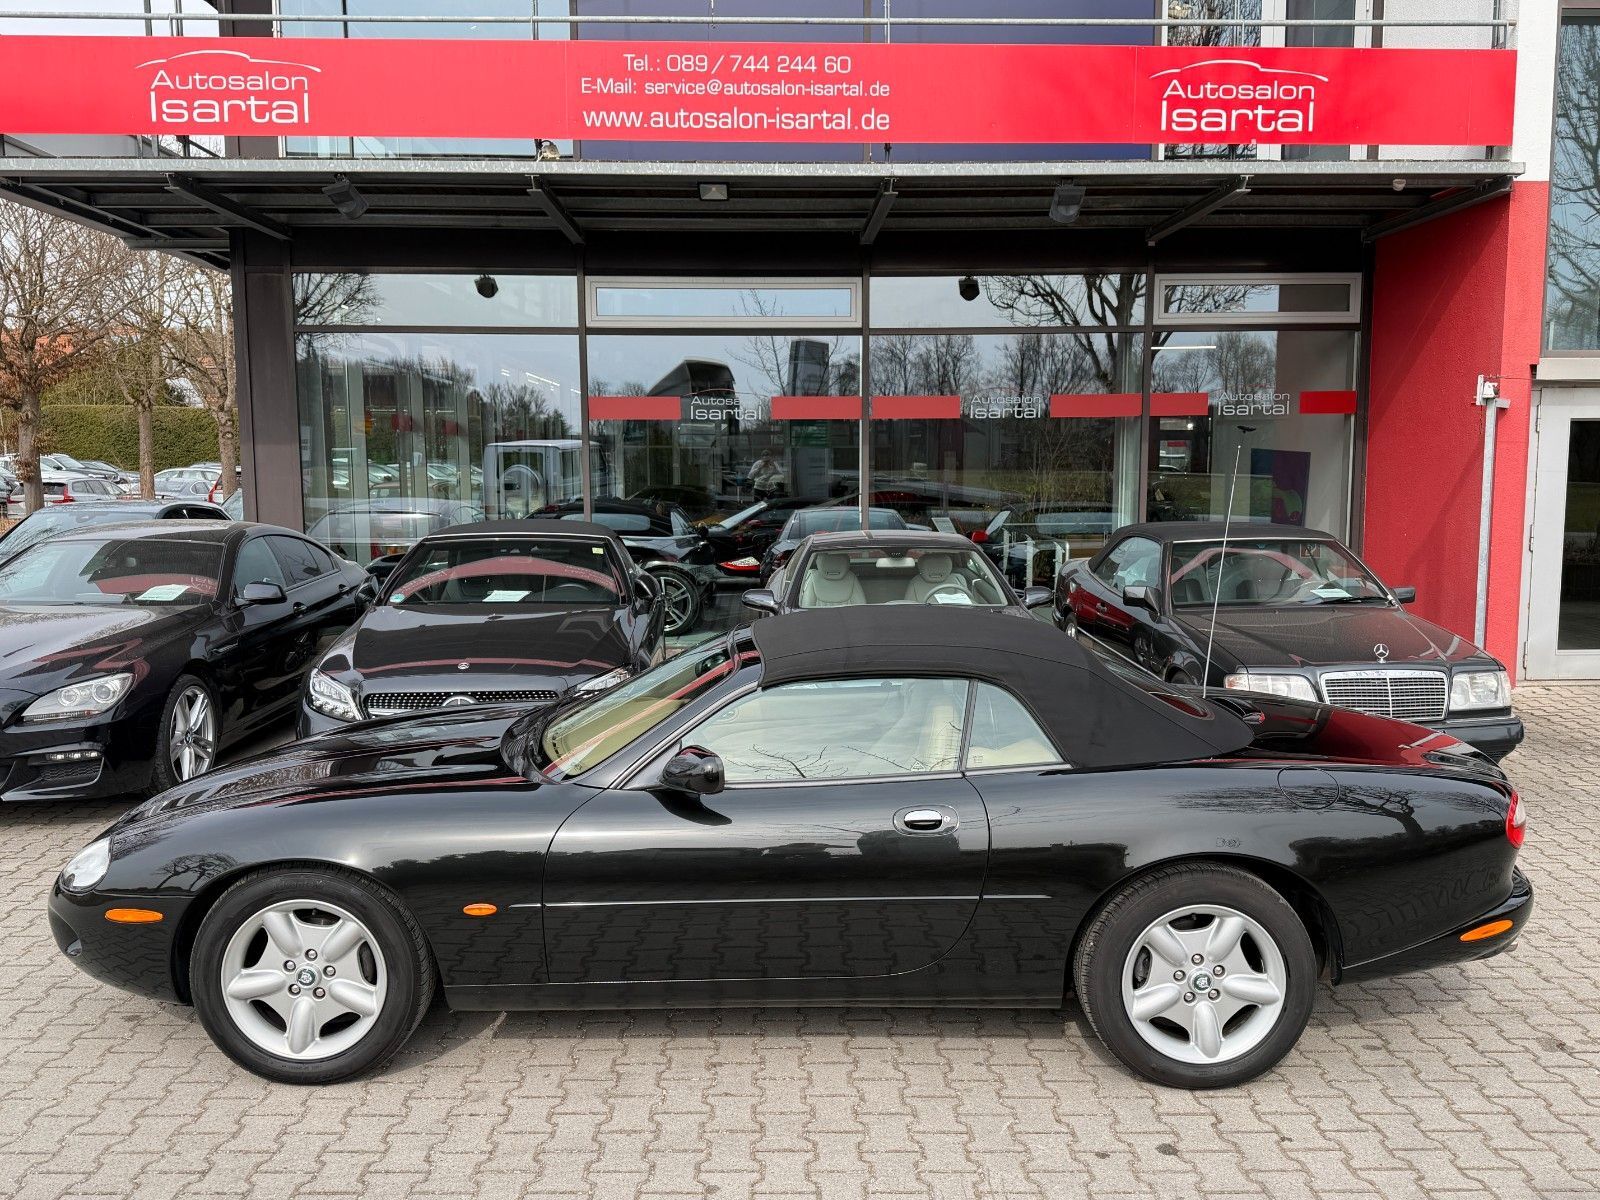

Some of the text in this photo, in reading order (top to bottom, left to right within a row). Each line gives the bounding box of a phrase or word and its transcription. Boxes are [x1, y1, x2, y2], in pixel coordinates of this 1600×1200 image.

[623, 54, 852, 75] Tel.: 089 / 744 244 60
[150, 69, 309, 91] Autosalon
[581, 77, 890, 97] E-Mail: service@autosalon-isartal.de
[1162, 79, 1315, 100] Autosalon
[150, 91, 310, 124] Isartal
[1160, 100, 1315, 132] Isartal
[582, 107, 890, 131] www.autosalon-isartal.de
[690, 395, 762, 406] Autosa
[971, 394, 1041, 404] Autosalon
[1219, 391, 1290, 401] Autosalon
[690, 405, 762, 420] Isartal
[969, 403, 1041, 419] Isartal
[1217, 400, 1290, 416] Isartal
